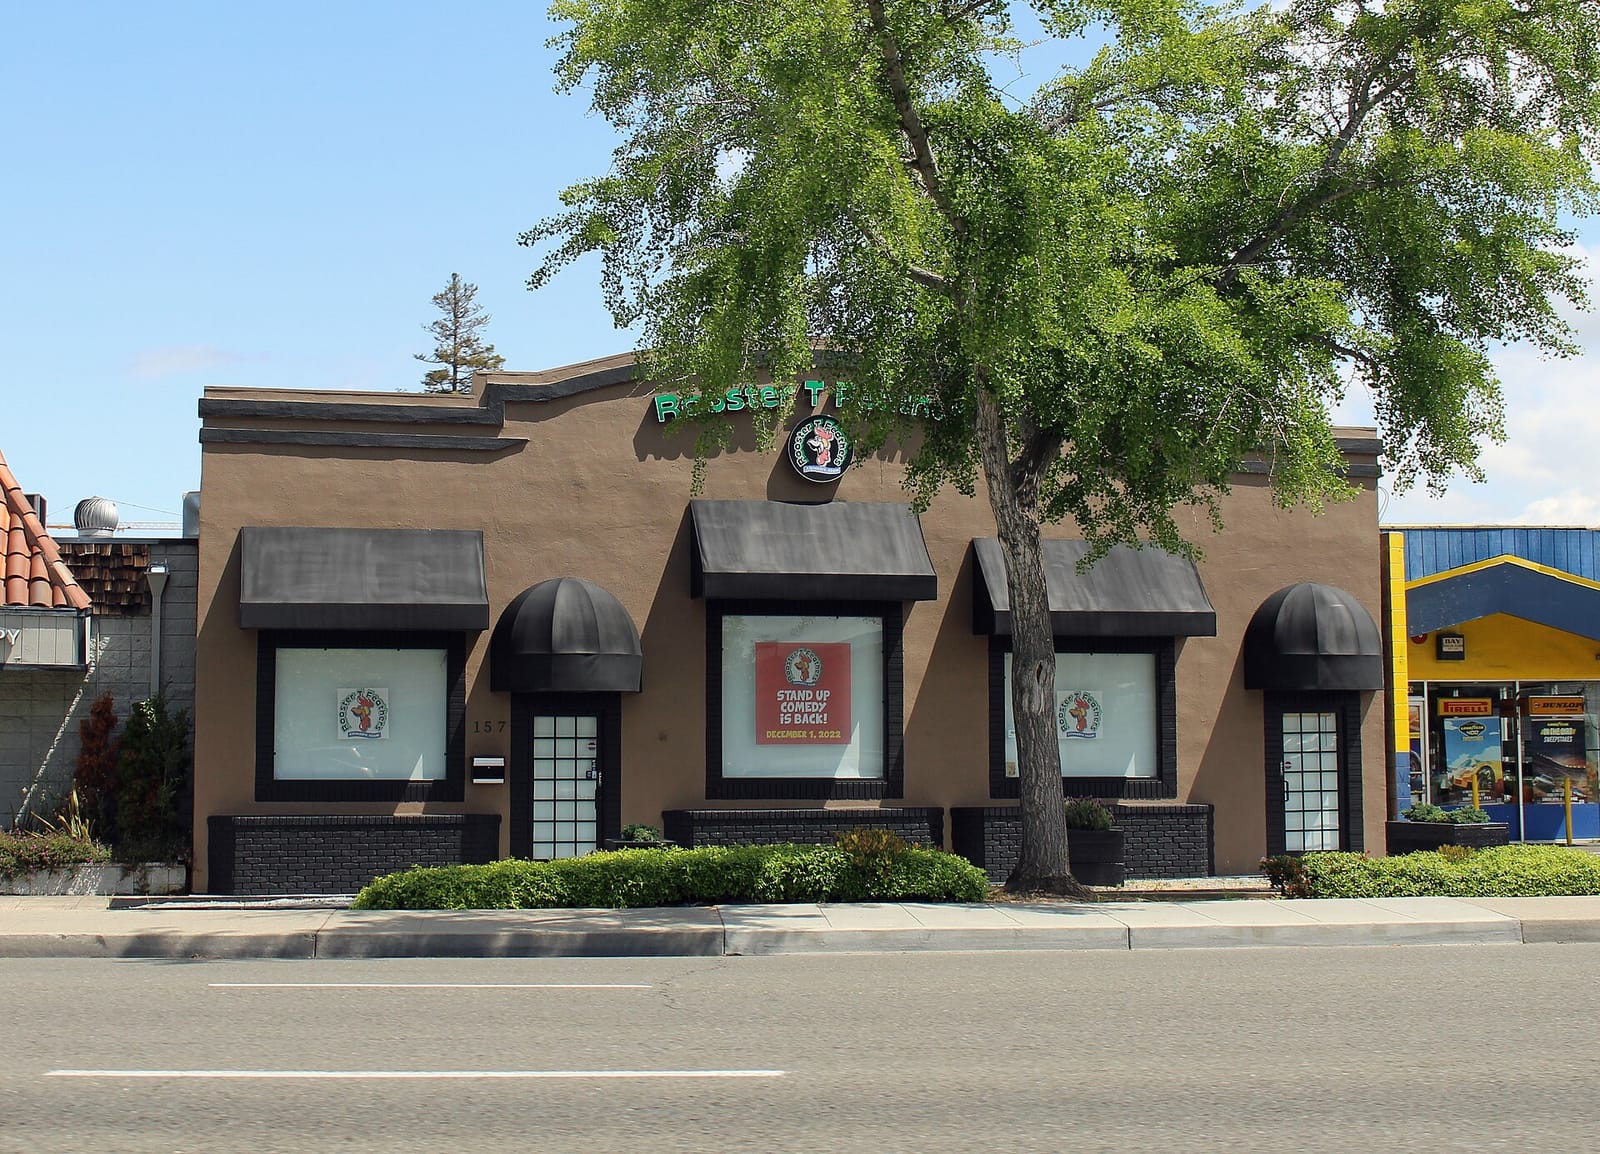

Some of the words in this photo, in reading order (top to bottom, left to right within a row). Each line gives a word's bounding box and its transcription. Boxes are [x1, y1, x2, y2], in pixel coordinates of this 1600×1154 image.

[804, 380, 825, 407] T
[794, 423, 813, 468] Rooster
[823, 420, 847, 467] Feathers
[776, 690, 813, 701] STAND
[815, 690, 831, 701] UP
[780, 701, 827, 713] COMEDY
[1443, 701, 1488, 713] PIRELLI
[793, 713, 828, 724] BACK!
[473, 721, 506, 733] 157
[766, 730, 807, 738] DECEMBER
[809, 730, 817, 739] 1,
[818, 730, 842, 738] 2022
